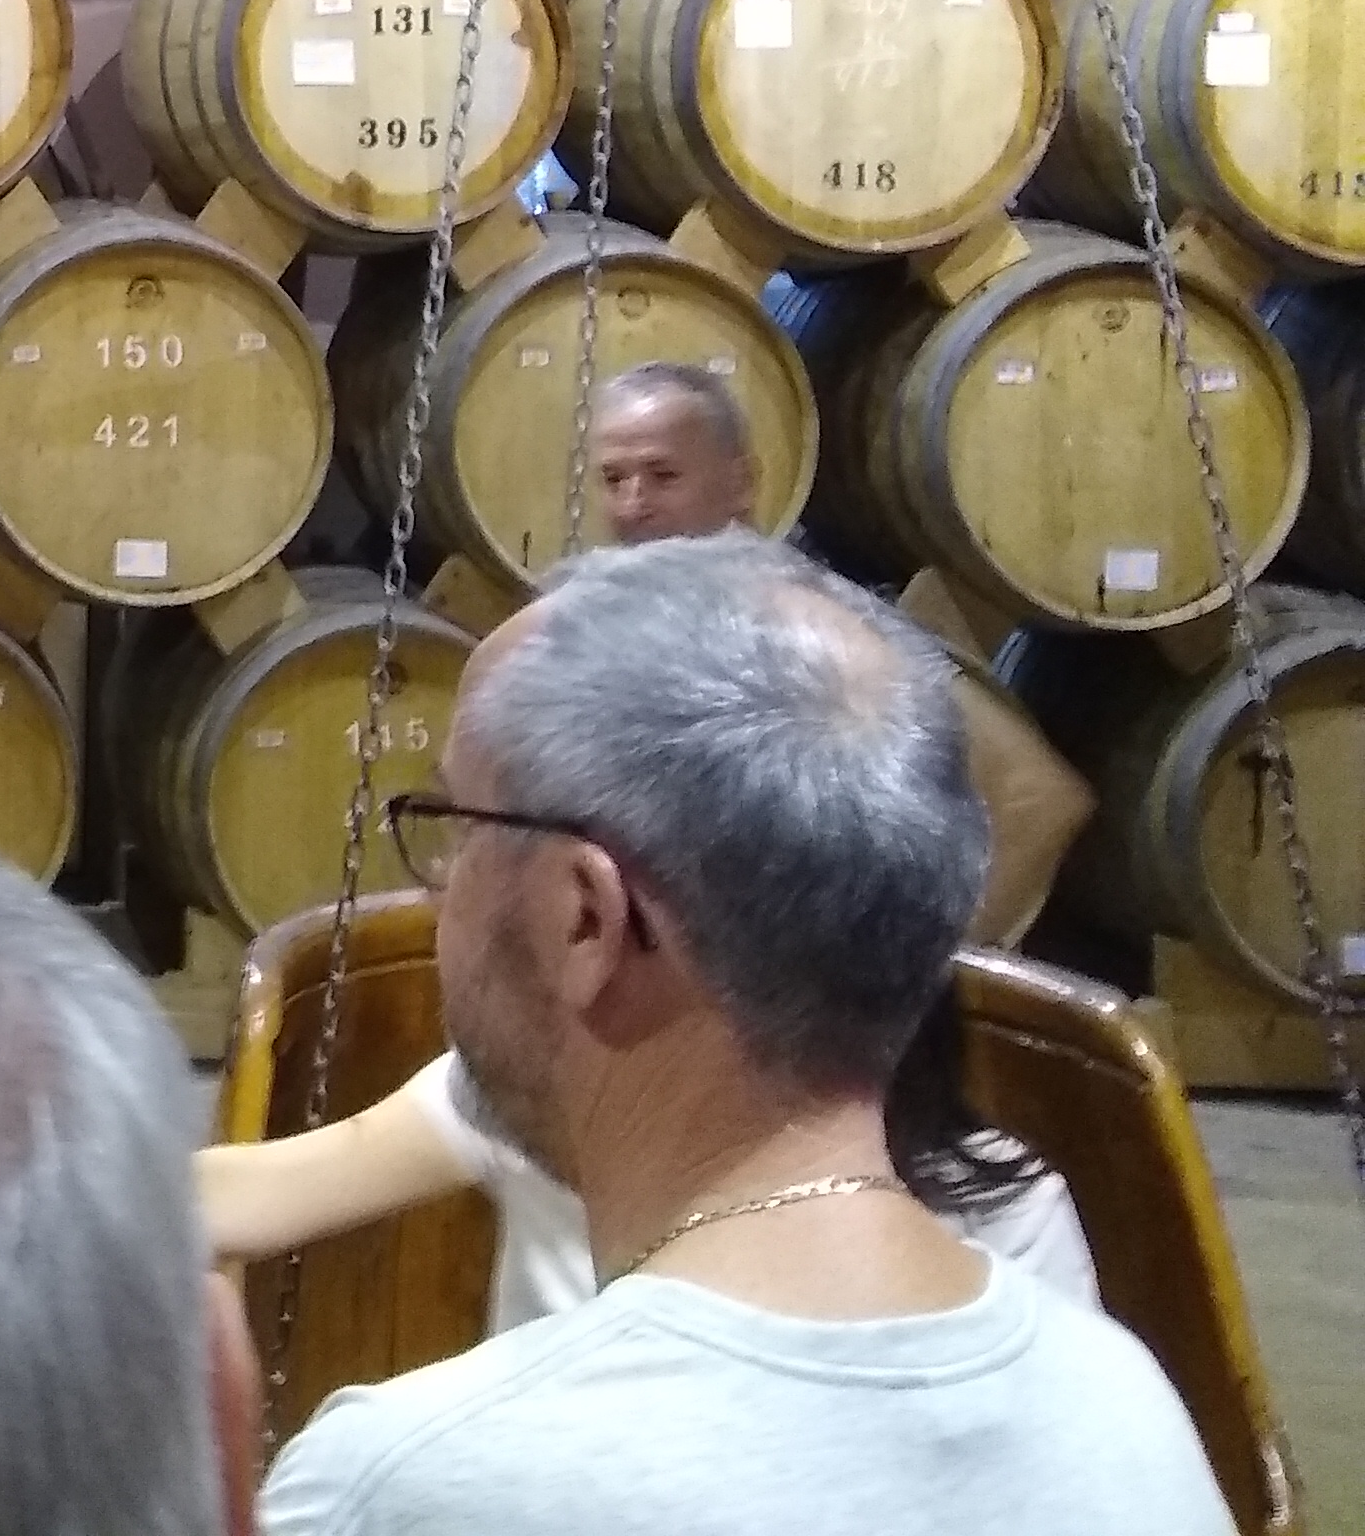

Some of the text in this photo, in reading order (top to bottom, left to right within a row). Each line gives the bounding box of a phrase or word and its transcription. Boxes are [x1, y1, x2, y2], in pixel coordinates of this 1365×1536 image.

[372, 5, 433, 36] 131
[358, 118, 439, 149] 395
[823, 160, 898, 193] 418
[96, 334, 184, 368] 150
[94, 415, 180, 448] 421
